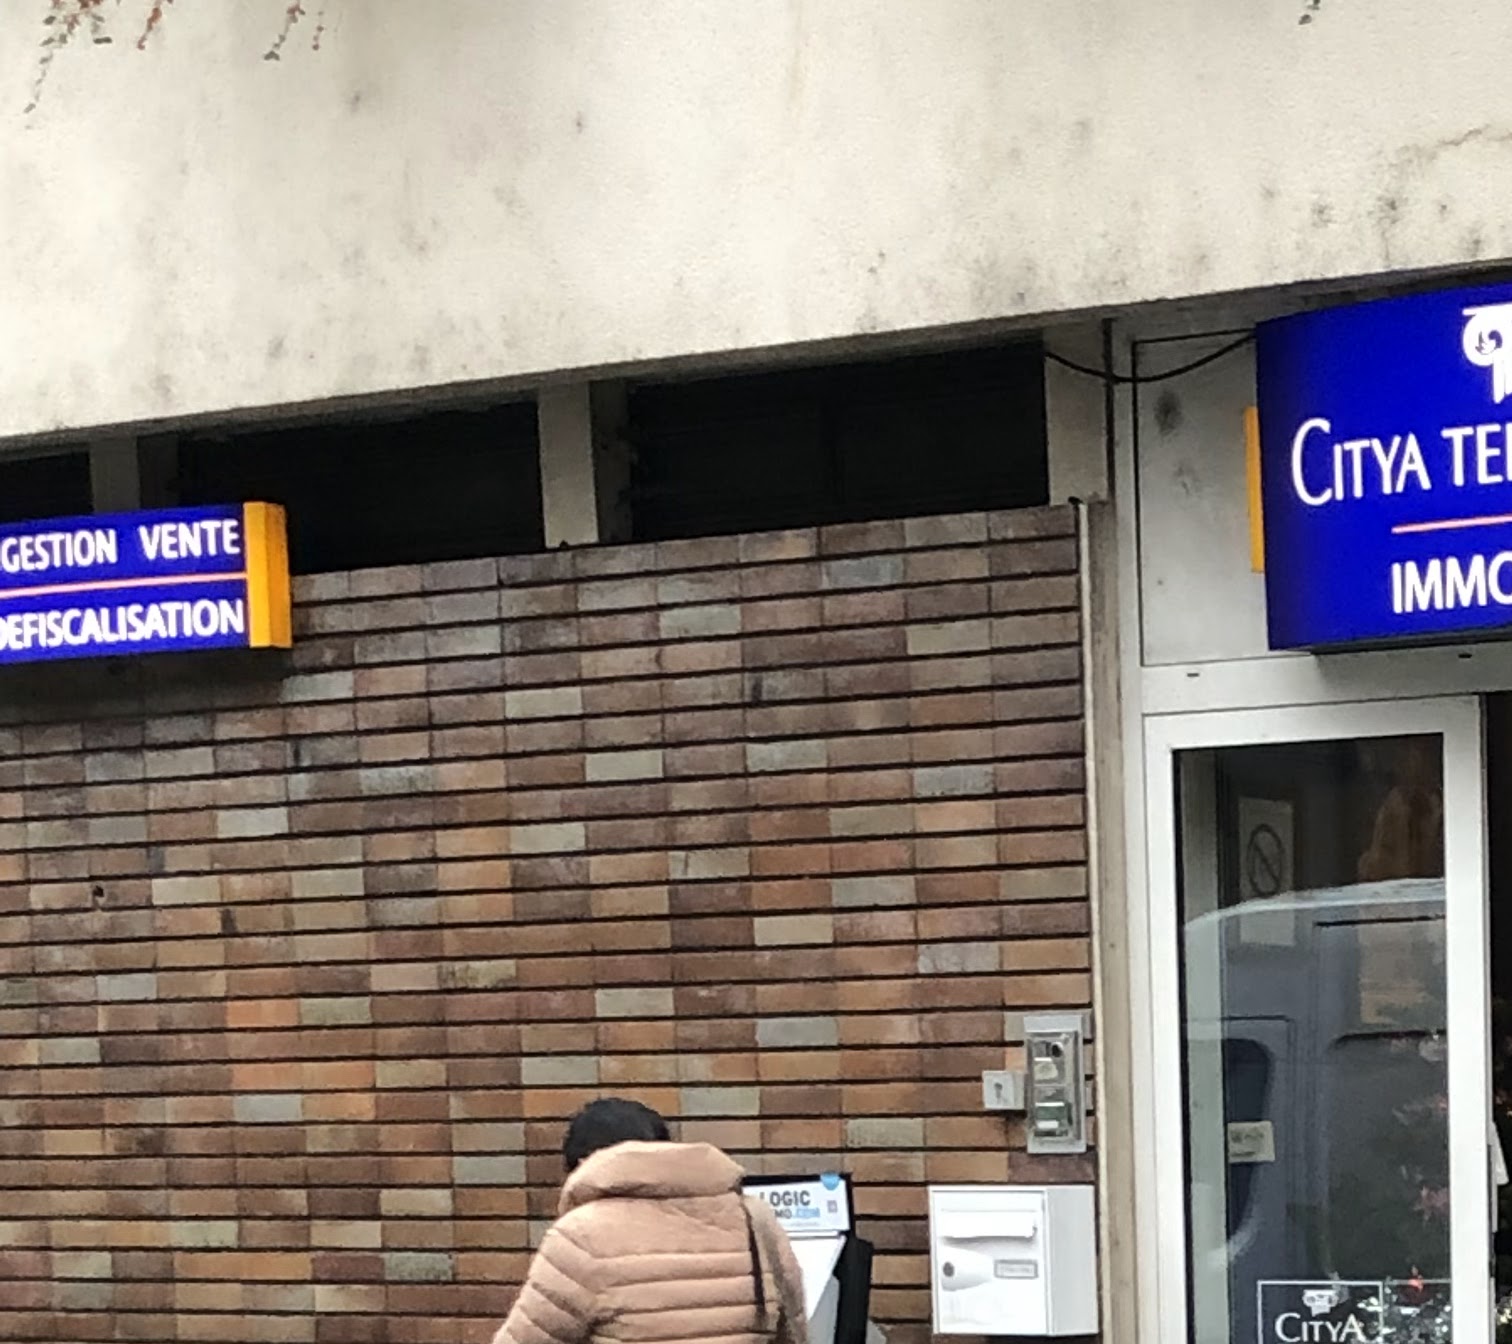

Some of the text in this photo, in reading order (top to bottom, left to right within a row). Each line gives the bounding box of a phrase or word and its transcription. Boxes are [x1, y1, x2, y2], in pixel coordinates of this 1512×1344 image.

[1291, 418, 1431, 506] CITYA
[1, 518, 241, 573] GESTION VENTE
[1275, 1312, 1367, 1343] CITYA
